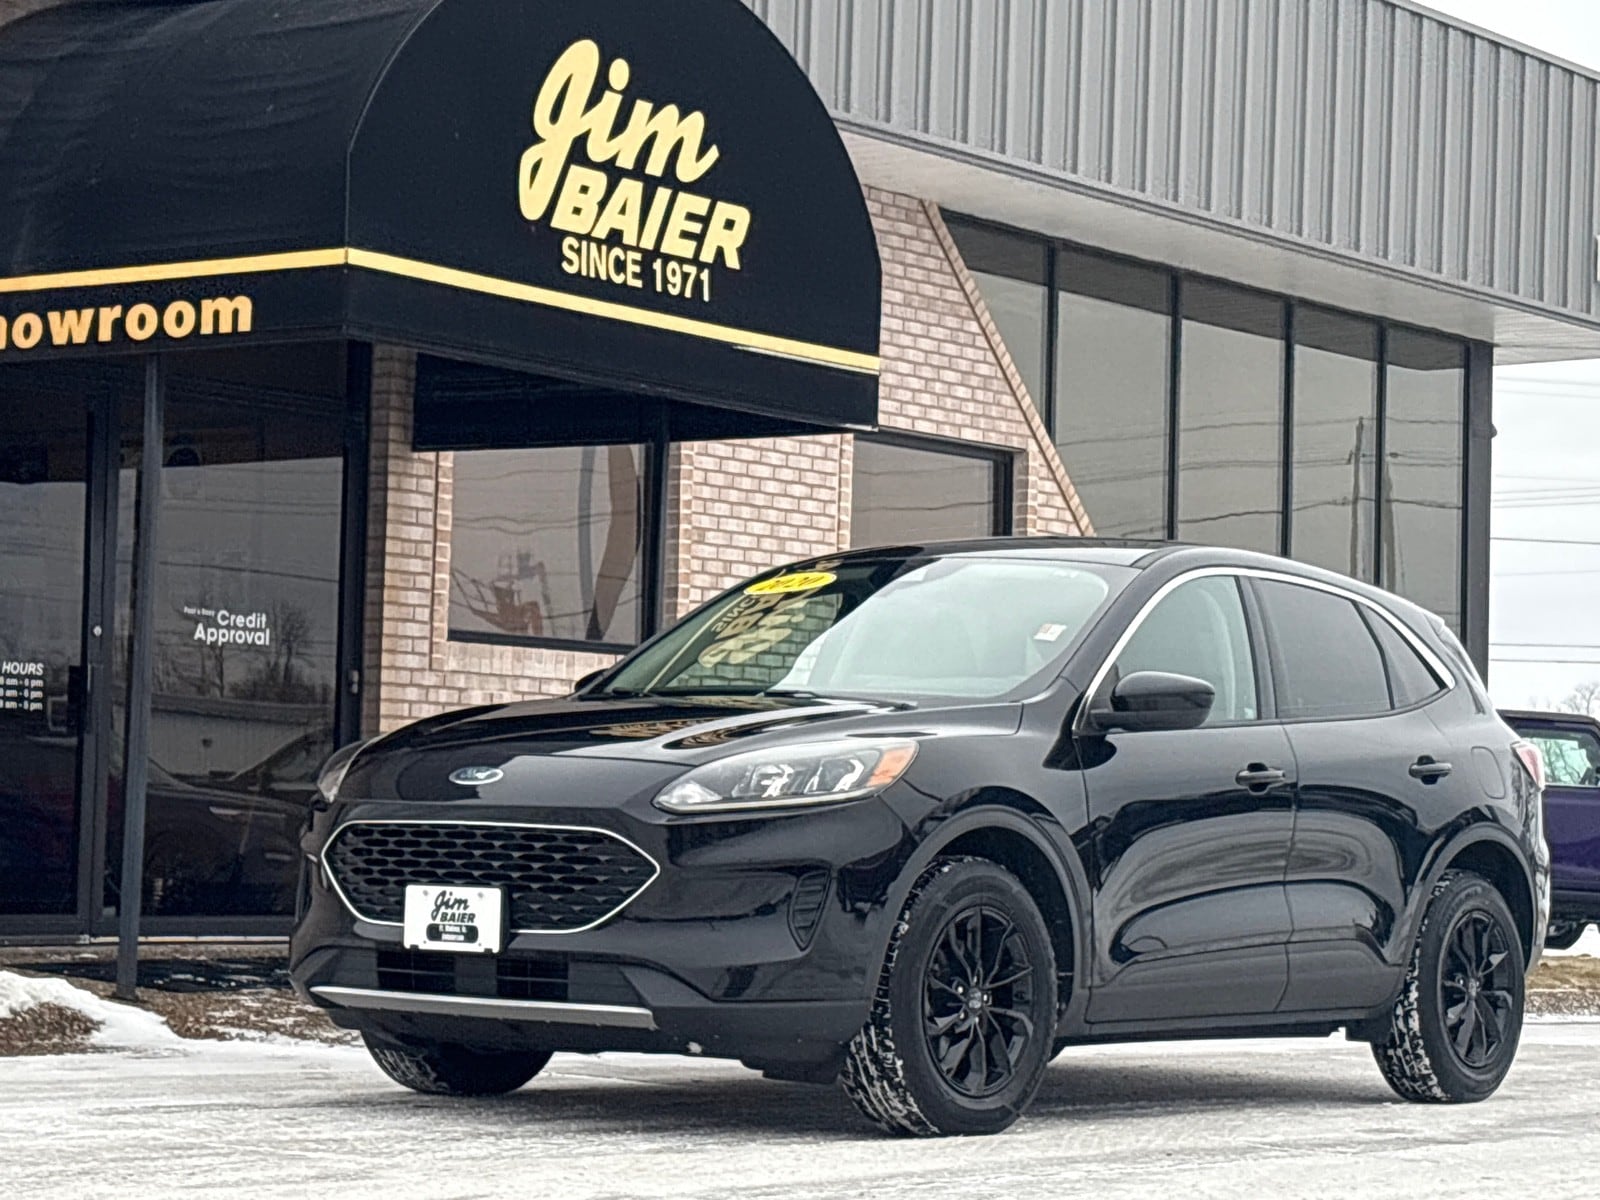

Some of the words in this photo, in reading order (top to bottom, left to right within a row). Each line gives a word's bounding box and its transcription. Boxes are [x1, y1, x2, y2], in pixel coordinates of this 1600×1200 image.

[518, 39, 719, 221] Jim
[550, 164, 750, 270] BAIER
[561, 236, 643, 288] SINCE
[652, 257, 709, 302] 1971
[0, 295, 253, 350] owroom
[193, 622, 270, 646] Approval
[217, 609, 267, 629] Credit
[2, 661, 44, 676] HOURS
[431, 890, 469, 921] Jim
[440, 912, 476, 923] BAIER
